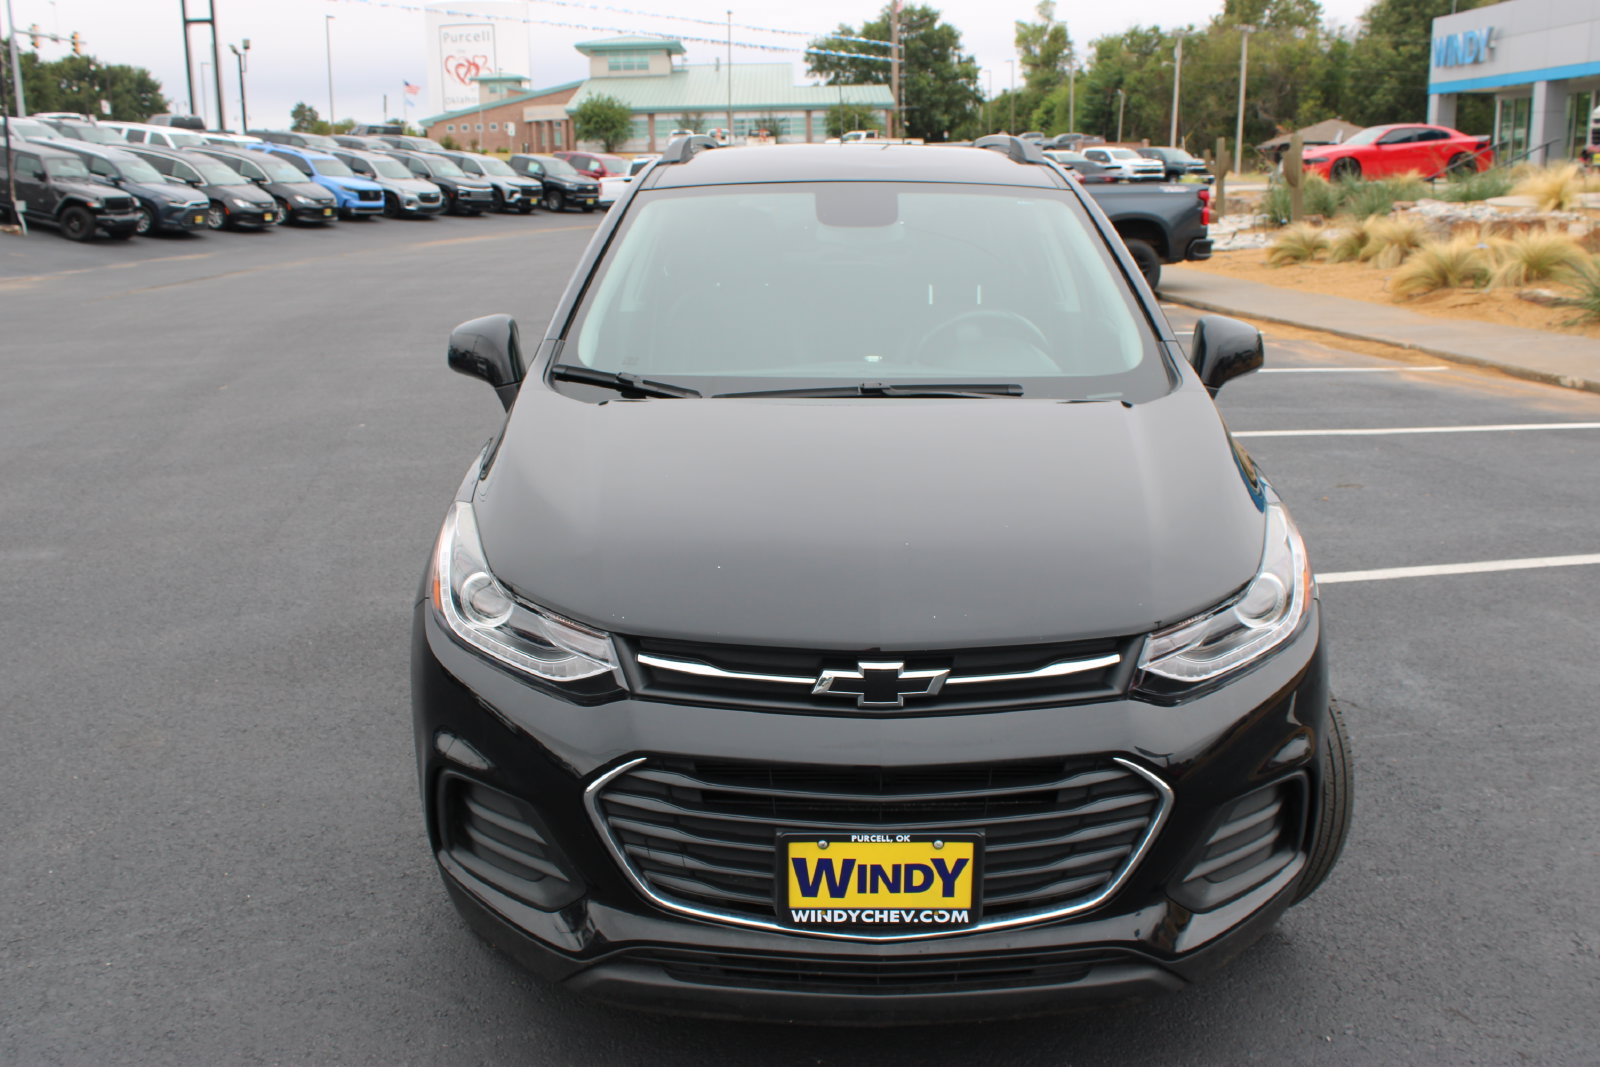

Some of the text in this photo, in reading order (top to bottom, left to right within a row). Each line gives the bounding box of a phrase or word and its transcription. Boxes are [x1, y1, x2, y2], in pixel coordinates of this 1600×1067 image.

[442, 31, 491, 43] Purcell
[1433, 26, 1494, 67] WINDY
[791, 909, 969, 923] WINDYCHEV.COM
